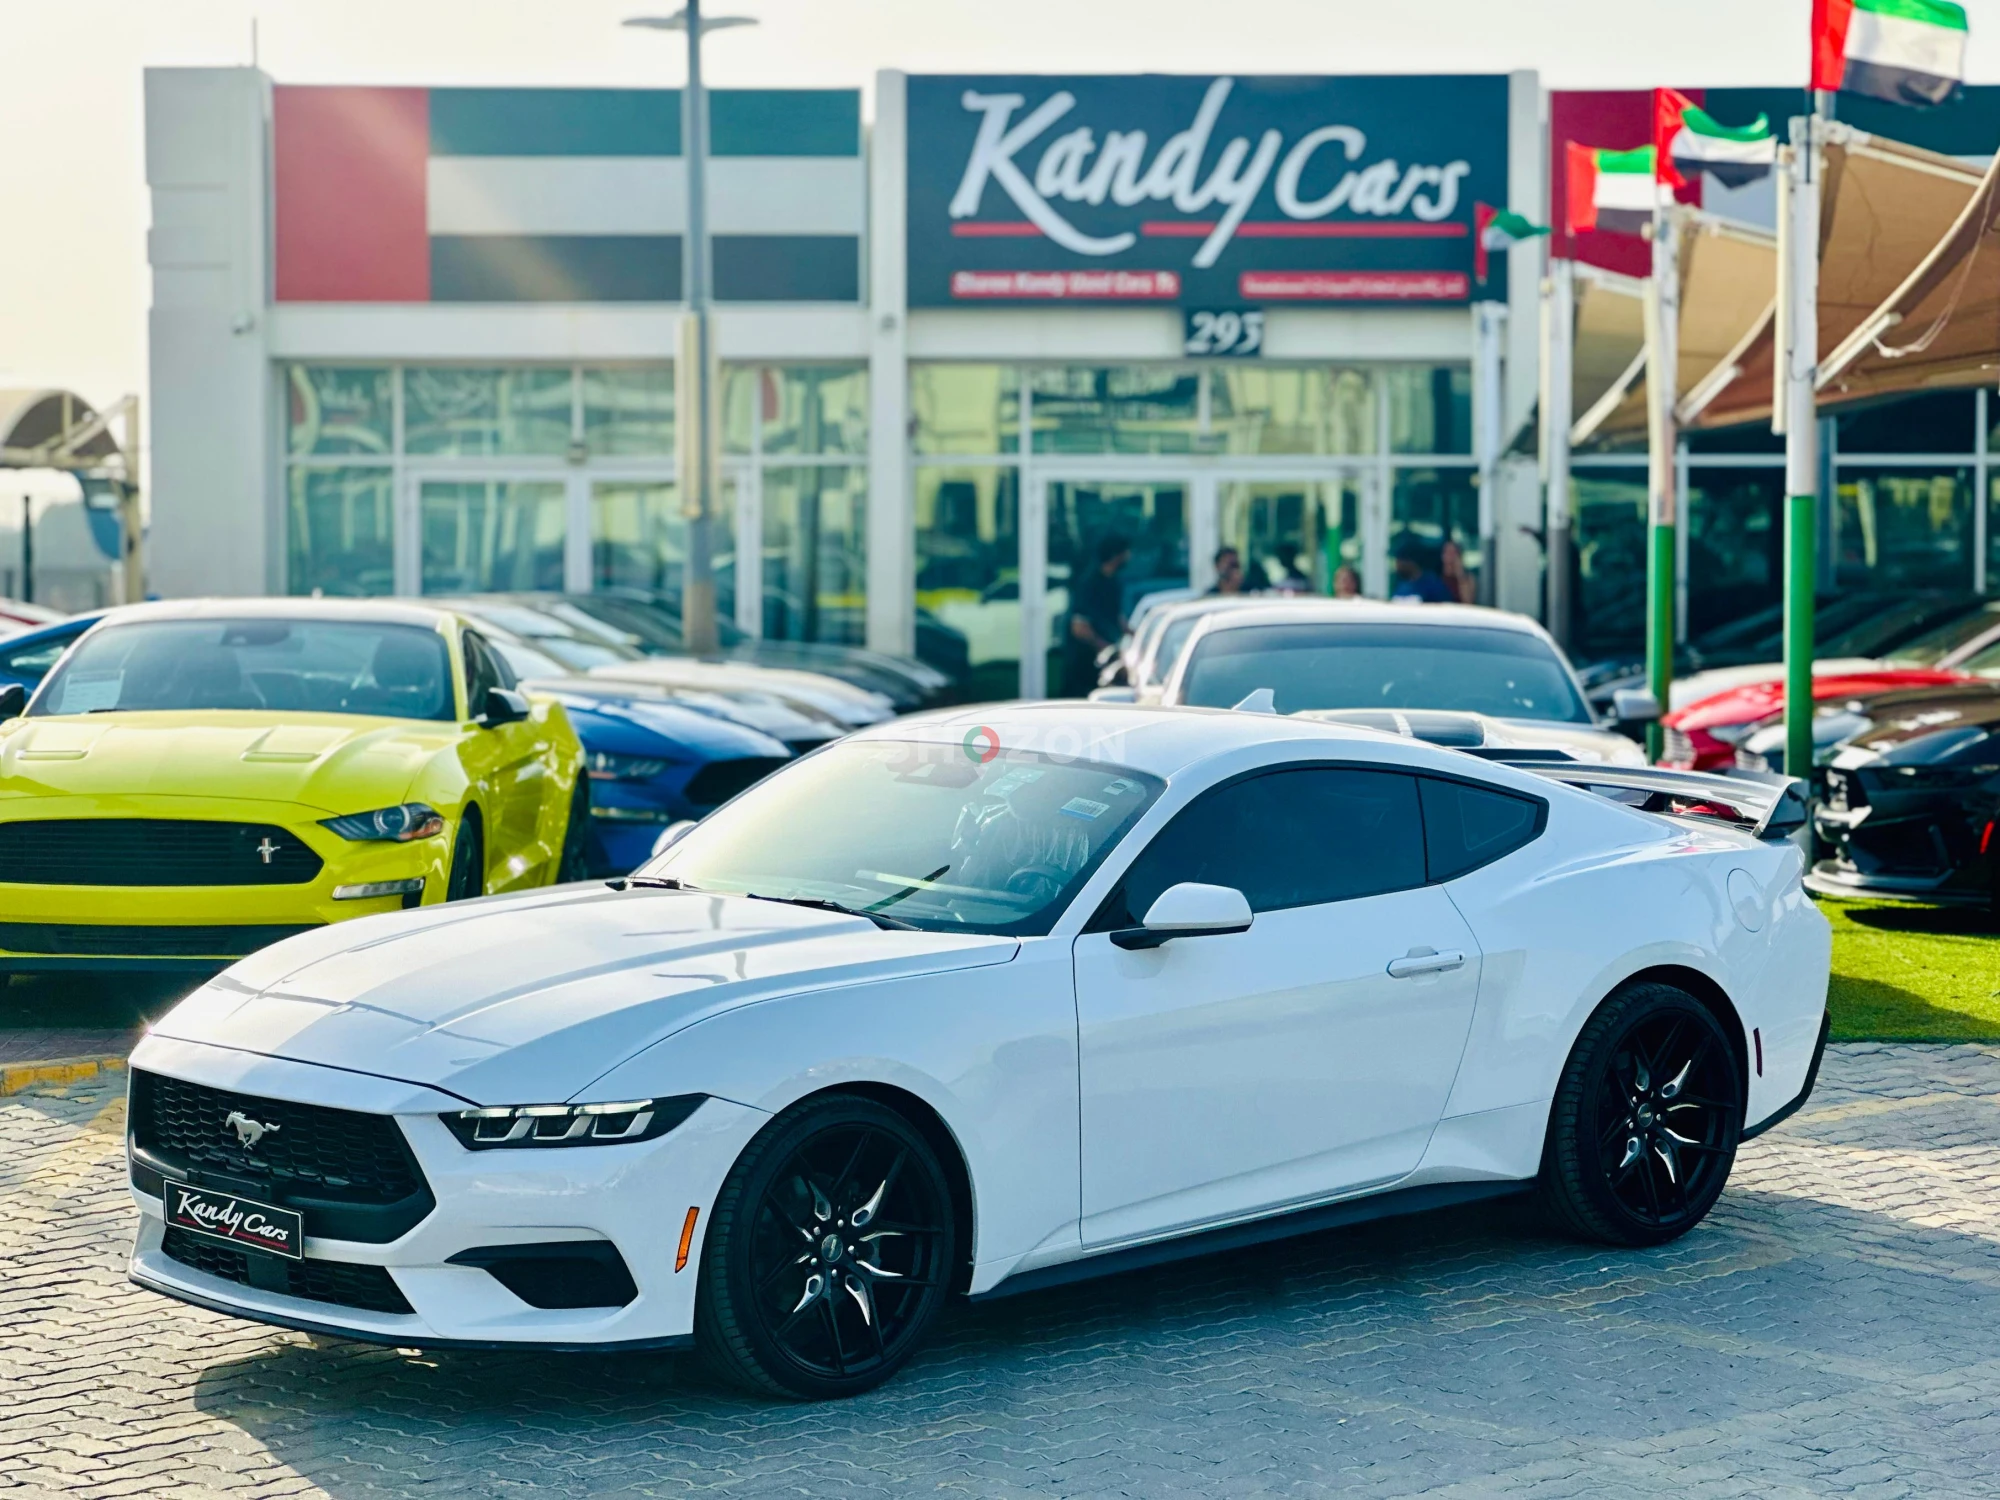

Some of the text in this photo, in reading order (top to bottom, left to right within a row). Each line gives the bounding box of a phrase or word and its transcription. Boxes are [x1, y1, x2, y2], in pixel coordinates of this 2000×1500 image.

[949, 76, 1471, 269] Kandy Cars
[1185, 310, 1264, 355] 295
[177, 1190, 289, 1241] Kandy Cars
